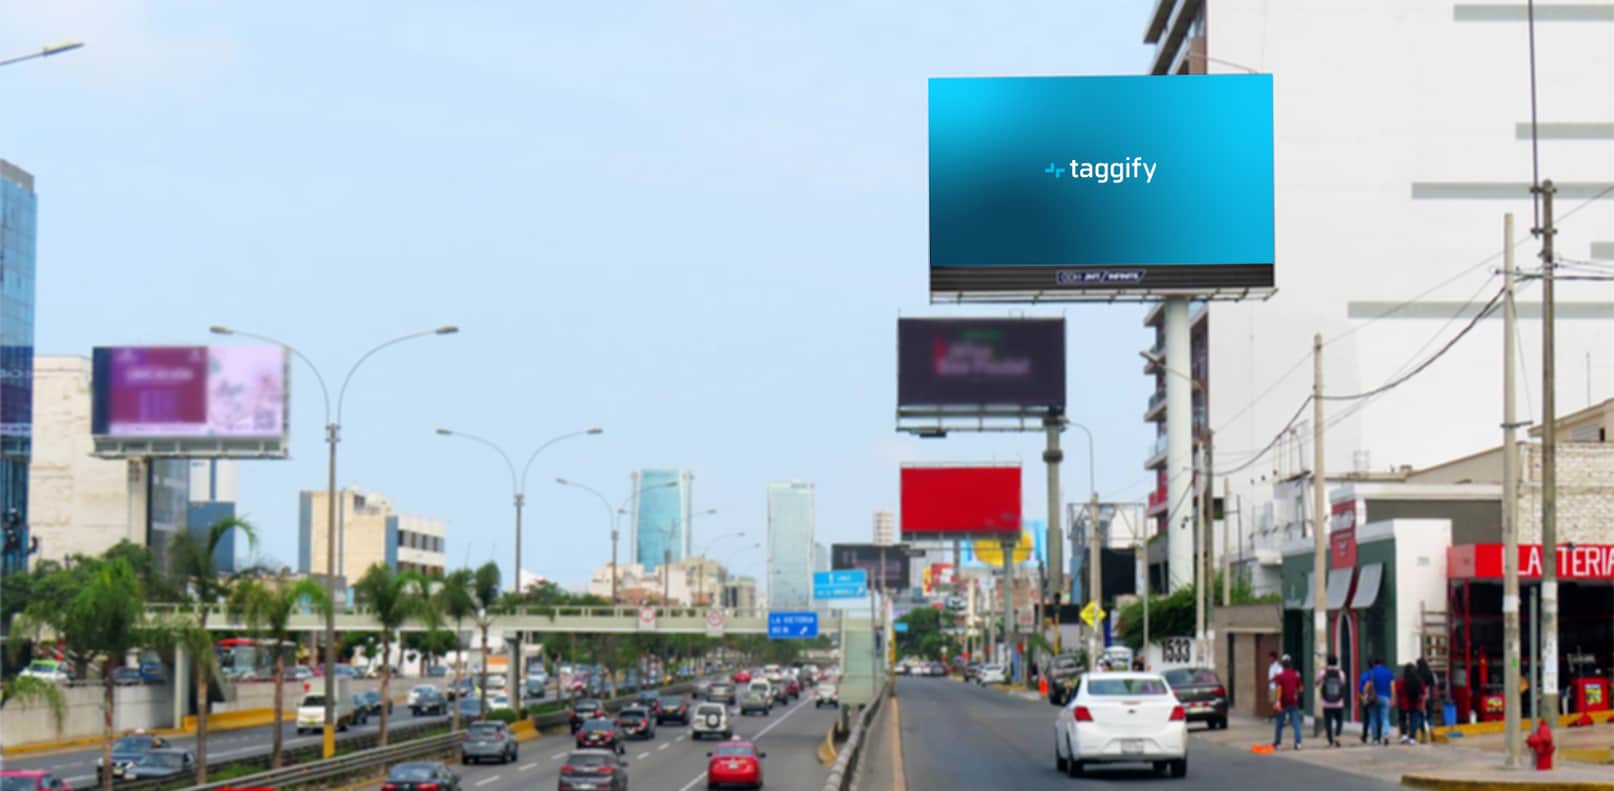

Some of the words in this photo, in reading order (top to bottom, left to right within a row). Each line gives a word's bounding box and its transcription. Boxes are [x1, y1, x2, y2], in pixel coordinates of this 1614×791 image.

[1069, 156, 1157, 184] taggify
[1502, 546, 1614, 576] LATERIA
[1162, 639, 1190, 663] 1533
